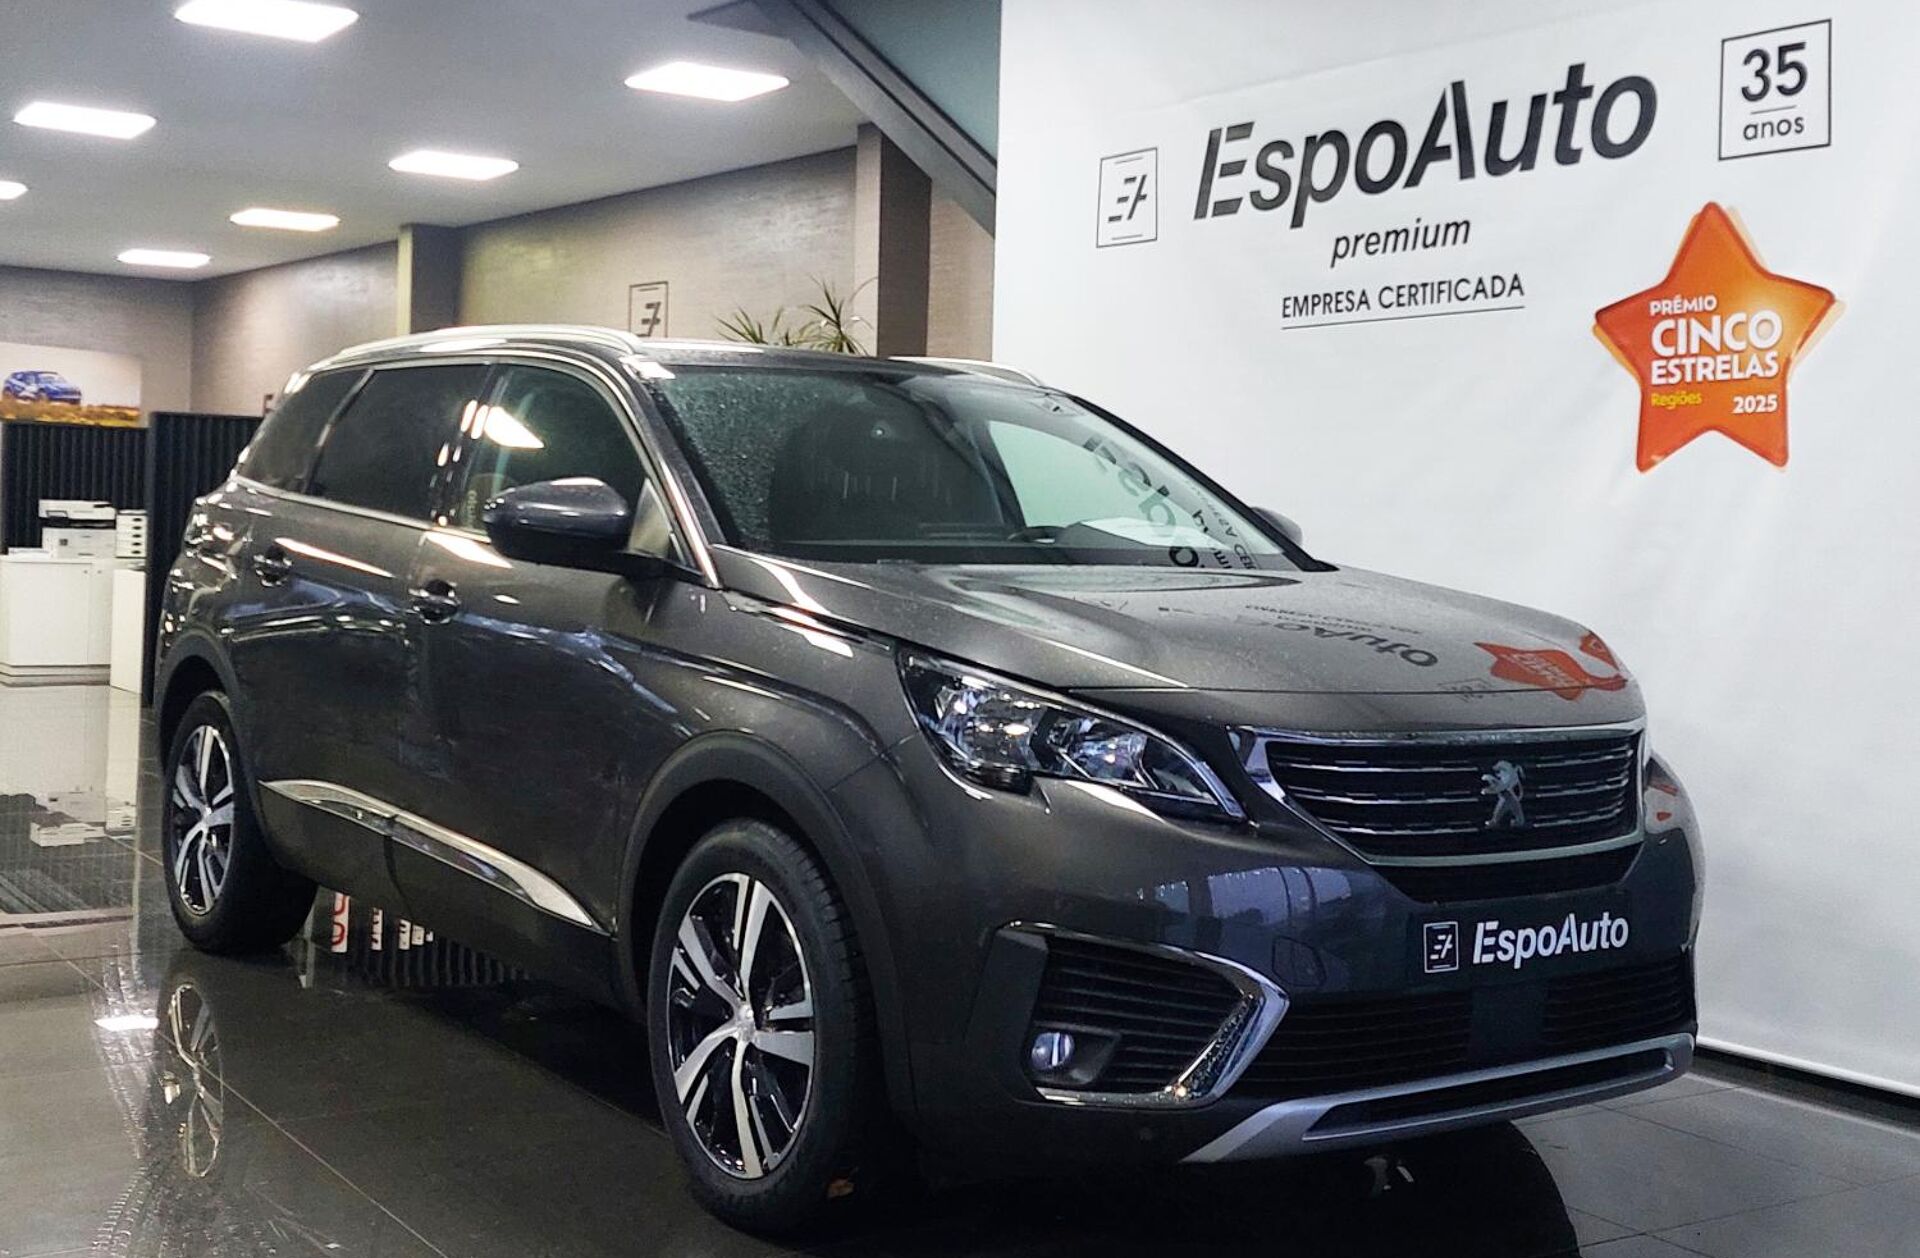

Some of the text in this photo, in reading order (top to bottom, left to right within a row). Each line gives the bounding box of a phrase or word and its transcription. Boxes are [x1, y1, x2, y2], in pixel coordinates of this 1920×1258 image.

[1741, 41, 1807, 102] 35
[1194, 62, 1657, 229] EspoAuto
[1743, 116, 1804, 140] anos
[1330, 217, 1470, 268] premium
[1282, 273, 1524, 319] EMPRESA CERTIFICADA
[1649, 294, 1717, 316] PRÉMIO
[1651, 310, 1782, 357] CINCO
[1651, 351, 1779, 385] ESTRELAS
[1651, 391, 1778, 414] Regiões 2025
[1472, 911, 1629, 969] EspoAuto
